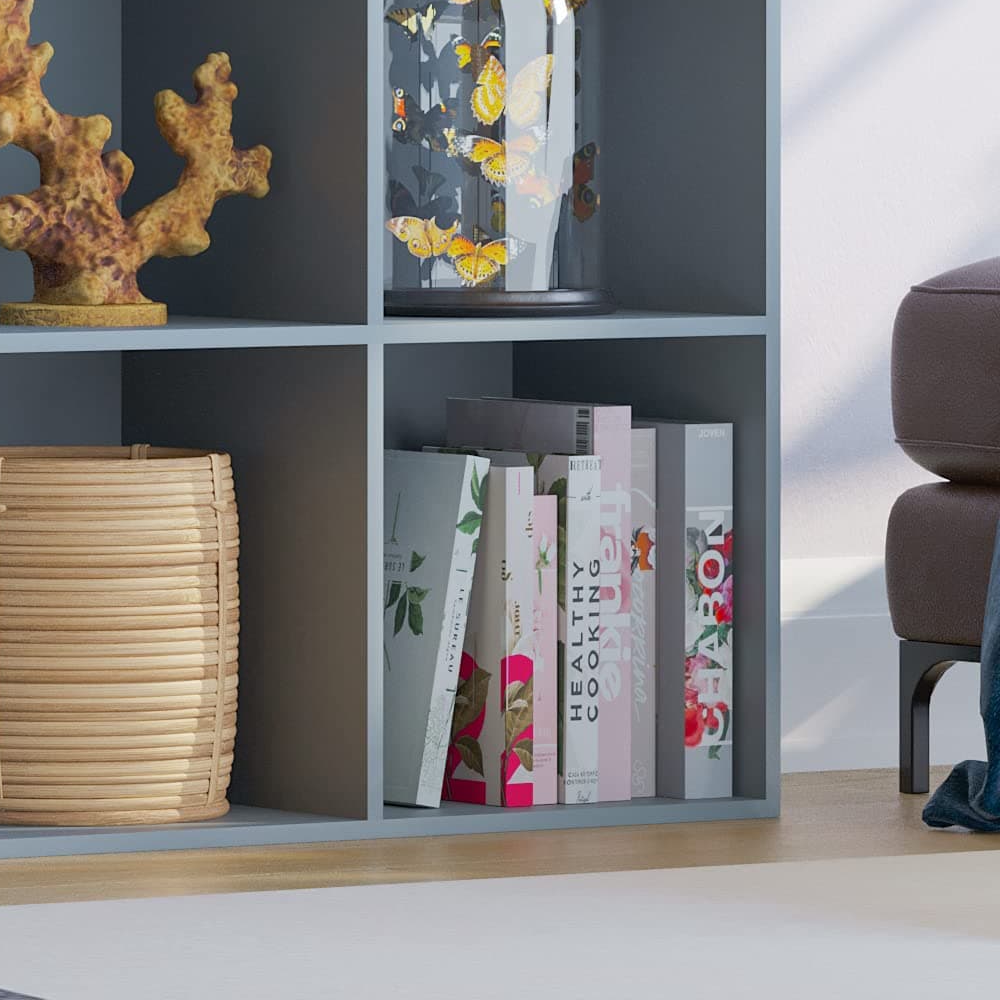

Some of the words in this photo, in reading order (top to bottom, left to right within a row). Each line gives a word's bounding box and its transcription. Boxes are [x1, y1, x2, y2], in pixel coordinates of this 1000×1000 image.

[569, 562, 585, 722] HEALTHY
[587, 558, 600, 723] COOKING
[599, 483, 632, 701] frankie
[697, 511, 725, 744] CHABON
